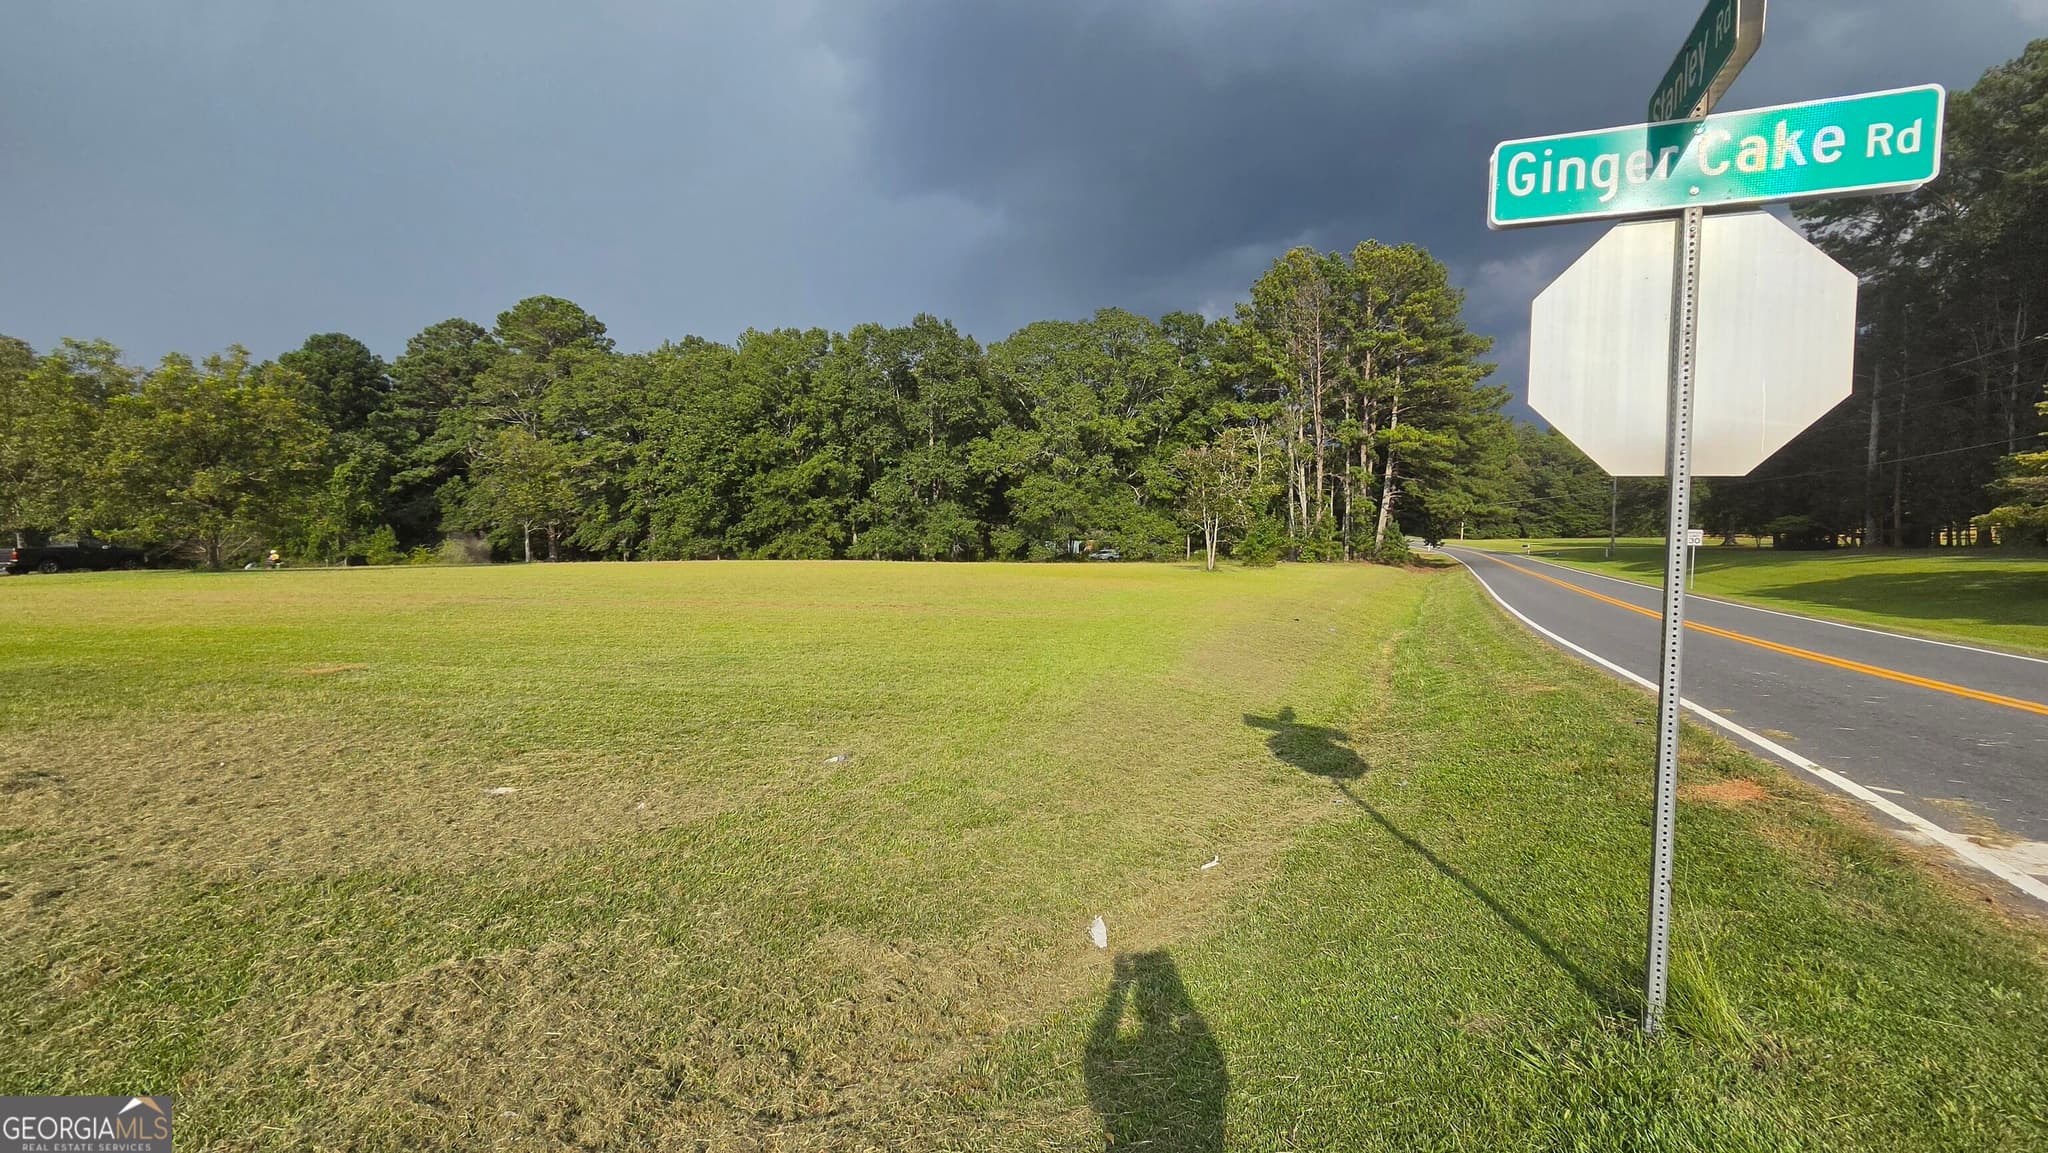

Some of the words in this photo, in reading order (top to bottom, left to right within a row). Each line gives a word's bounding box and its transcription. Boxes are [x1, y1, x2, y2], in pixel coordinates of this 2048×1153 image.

[1653, 28, 1709, 121] Stanley
[1715, 0, 1732, 48] Rd
[1507, 145, 1679, 202] Ginger
[1698, 119, 1846, 177] Cake
[1866, 117, 1922, 158] Rd
